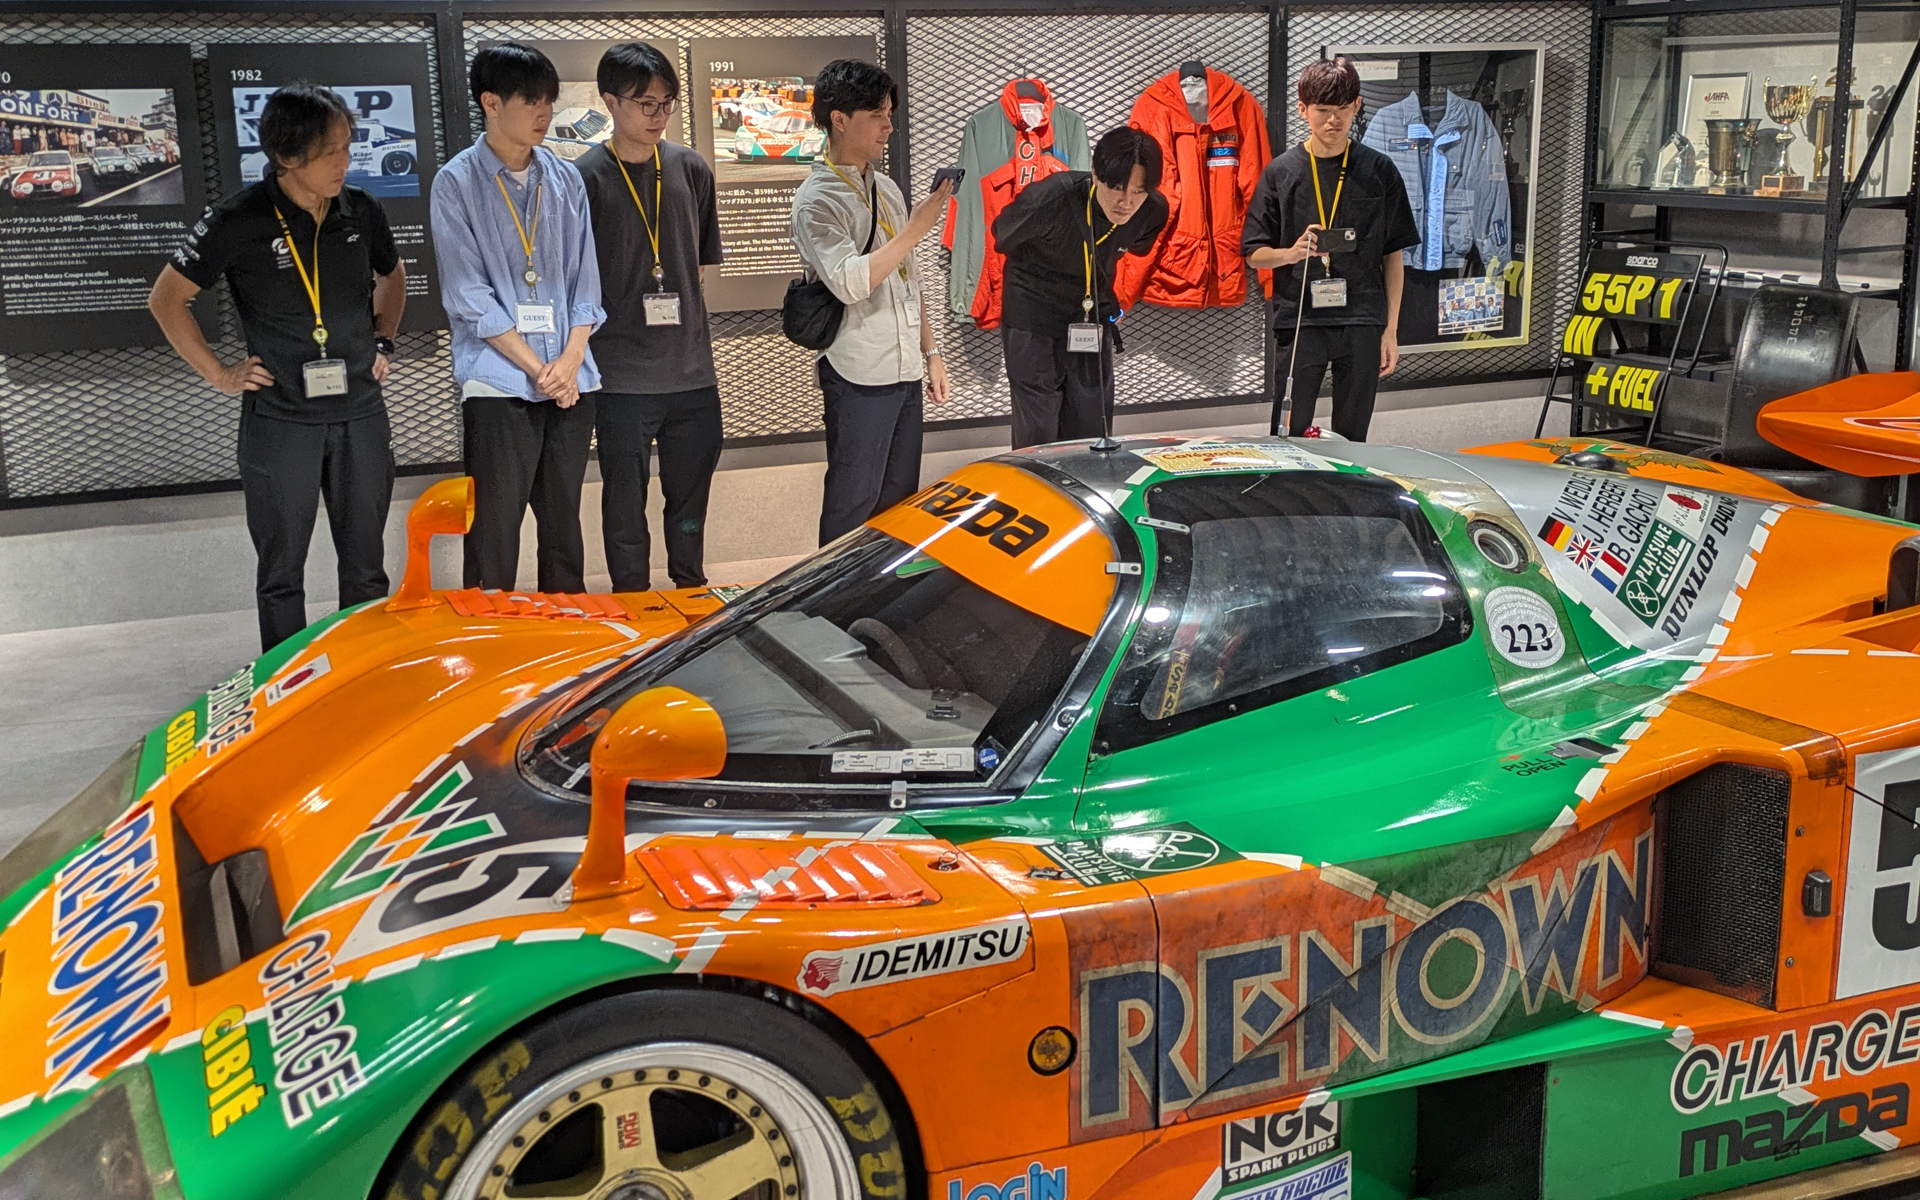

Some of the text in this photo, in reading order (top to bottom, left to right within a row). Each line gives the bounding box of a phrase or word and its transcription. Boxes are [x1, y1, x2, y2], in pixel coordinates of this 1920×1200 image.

[230, 69, 263, 81] 1982
[709, 61, 735, 72] 1991
[64, 271, 84, 279] Coupe
[1625, 254, 1659, 268] sparco
[523, 313, 547, 322] GUEST
[1581, 272, 1682, 319] 55P 1
[1563, 315, 1605, 356] IN
[1609, 365, 1661, 412] FUEL
[1161, 449, 1245, 461] Catégorie
[1635, 523, 1673, 582] PLAYSURE
[1655, 545, 1680, 579] CLUB
[1660, 534, 1719, 642] DUNLOP
[1500, 622, 1553, 654] 223
[206, 660, 257, 759] CHARGE
[1501, 756, 1553, 772] PULL
[1515, 759, 1568, 777] OPEN
[1062, 852, 1098, 876] CLUB
[44, 805, 172, 1104] RENOWN
[850, 925, 1024, 985] IDEMITSU
[1079, 826, 1654, 1129] RENOWN
[257, 928, 367, 1129] CHARGE
[1670, 1004, 1920, 1115] CHARGE
[622, 1111, 641, 1149] MAG
[1229, 1099, 1336, 1165] NGK
[1678, 1081, 1910, 1179] mazda
[1228, 1135, 1336, 1183] SPARK PLUGS
